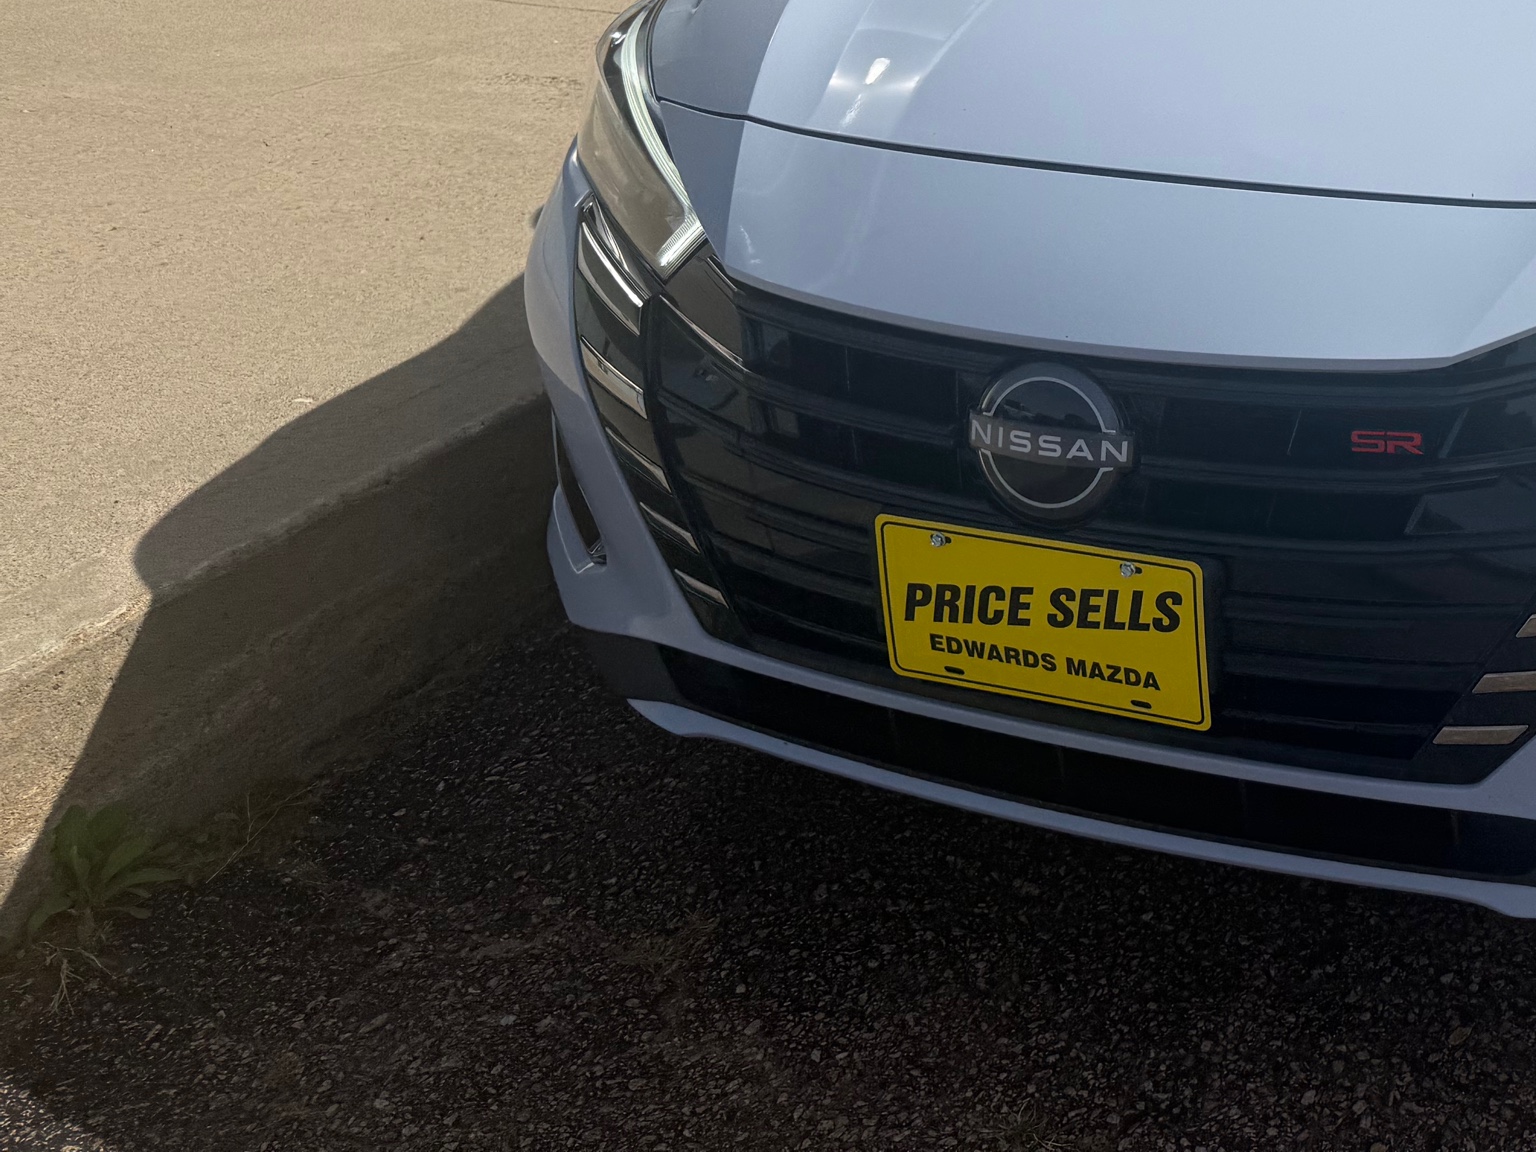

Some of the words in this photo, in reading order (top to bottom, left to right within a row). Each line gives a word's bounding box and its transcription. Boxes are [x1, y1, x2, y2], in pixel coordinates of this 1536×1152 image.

[970, 418, 1129, 462] NISSAN
[1351, 431, 1424, 454] SR
[904, 583, 1034, 626] PRICE
[1046, 587, 1183, 633] SELLS
[929, 633, 1057, 672] EDWARDS
[1066, 657, 1161, 691] MAZDA
